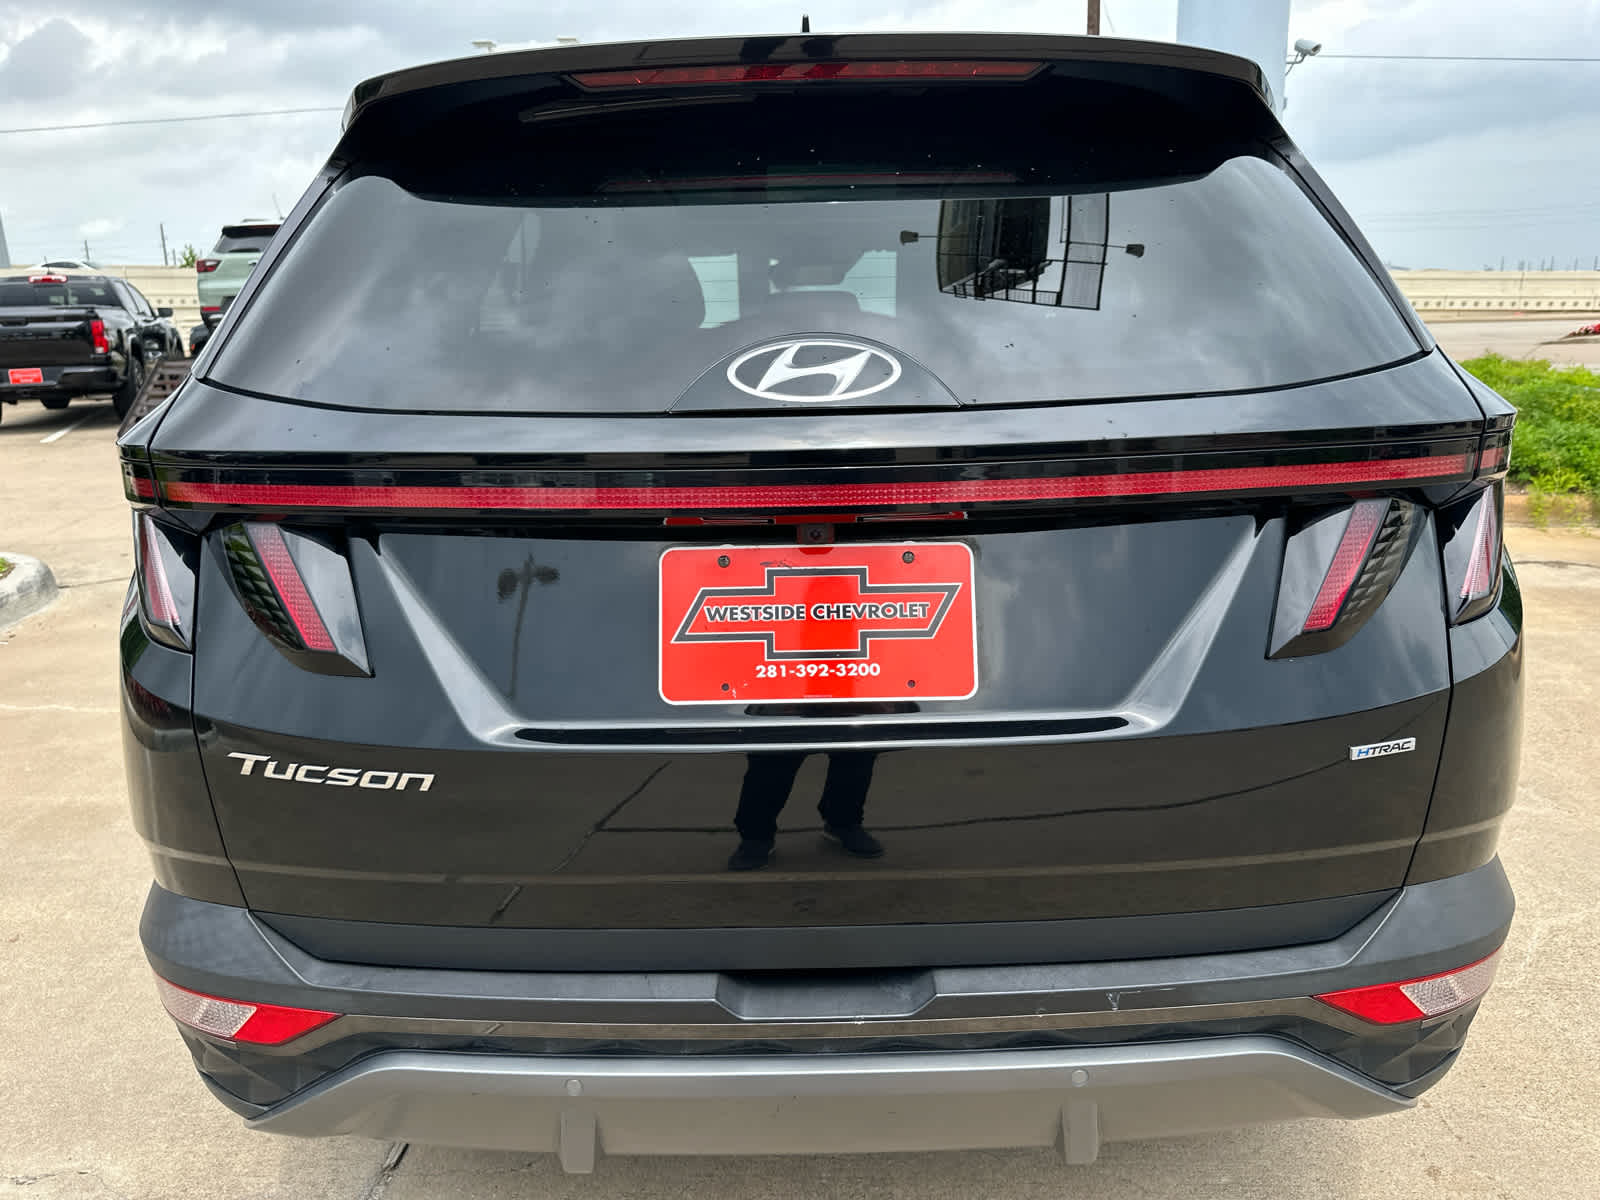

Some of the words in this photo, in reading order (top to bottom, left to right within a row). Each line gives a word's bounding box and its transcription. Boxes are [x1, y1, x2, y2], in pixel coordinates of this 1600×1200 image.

[704, 605, 806, 621] WESTSIDE
[811, 603, 930, 619] CHEVROLET
[756, 663, 881, 678] 281-392-3200
[1357, 740, 1411, 757] HTRAC
